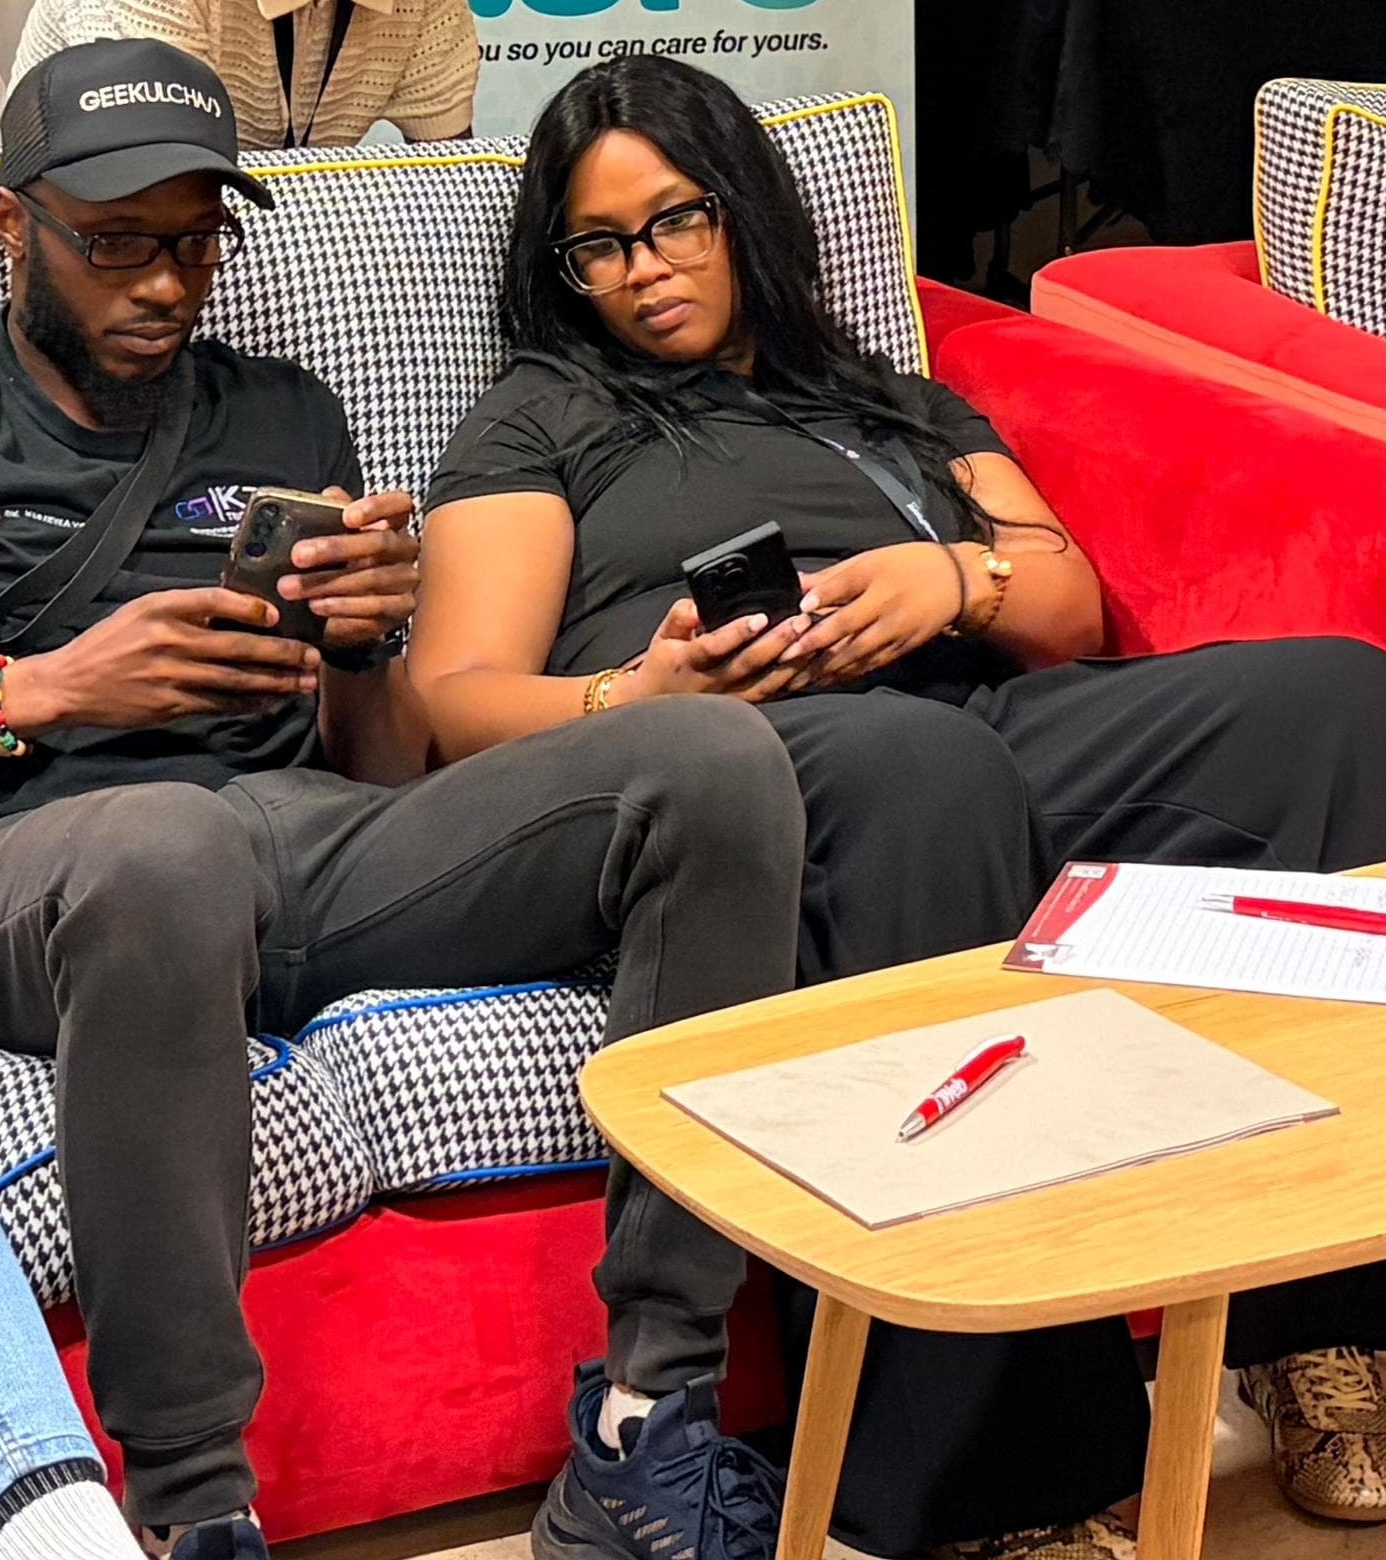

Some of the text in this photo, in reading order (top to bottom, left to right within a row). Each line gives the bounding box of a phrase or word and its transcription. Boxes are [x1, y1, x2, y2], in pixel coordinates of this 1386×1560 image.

[506, 42, 538, 61] so
[543, 40, 592, 66] you
[598, 39, 645, 58] can
[651, 36, 707, 55] care
[713, 29, 748, 53] for
[751, 32, 828, 58] yours.
